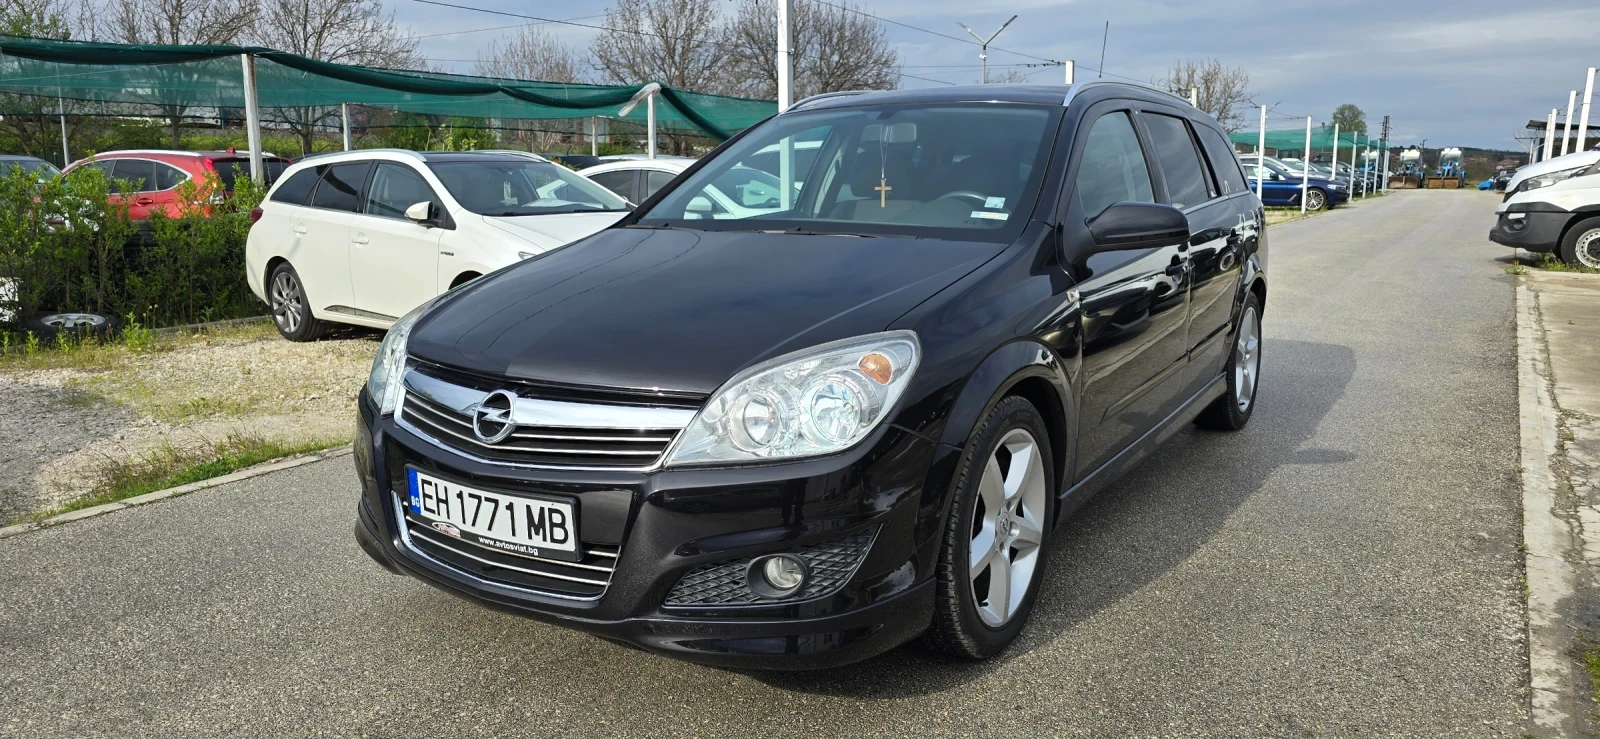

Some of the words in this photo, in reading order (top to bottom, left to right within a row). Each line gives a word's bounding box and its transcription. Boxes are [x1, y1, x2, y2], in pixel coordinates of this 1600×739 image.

[411, 495, 420, 508] BG
[421, 478, 450, 520] EH
[456, 490, 516, 537] 1771
[526, 504, 569, 544] MB
[478, 536, 539, 556] www.avtosviat.bg
